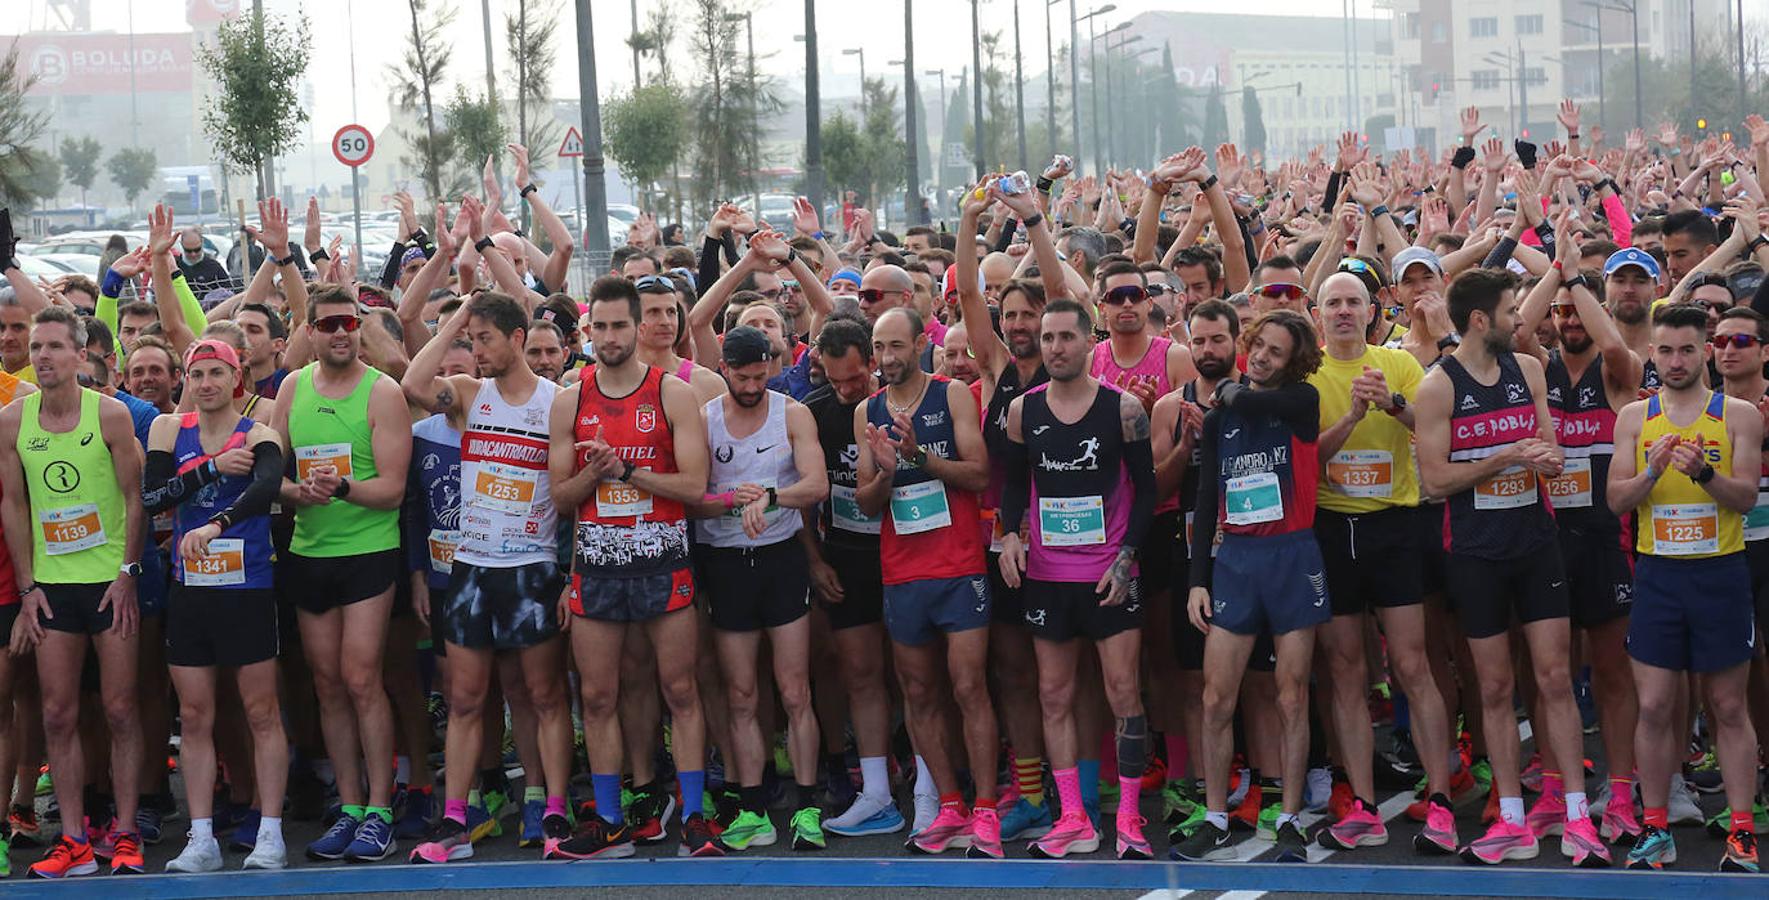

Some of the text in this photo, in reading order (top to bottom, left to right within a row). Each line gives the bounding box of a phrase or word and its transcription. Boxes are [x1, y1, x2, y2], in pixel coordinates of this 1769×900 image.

[72, 50, 174, 65] BOLUDA
[341, 137, 366, 152] 50
[1344, 471, 1379, 485] 1337
[487, 482, 520, 500] 1253
[1490, 479, 1526, 496] 1293
[1545, 480, 1579, 495] 1256
[607, 489, 640, 503] 1353
[1243, 497, 1253, 511] 4
[910, 505, 921, 519] 3
[53, 524, 88, 542] 1139
[1061, 518, 1081, 533] 36
[1665, 526, 1705, 541] 1225
[439, 549, 455, 564] 12
[195, 558, 229, 573] 1341
